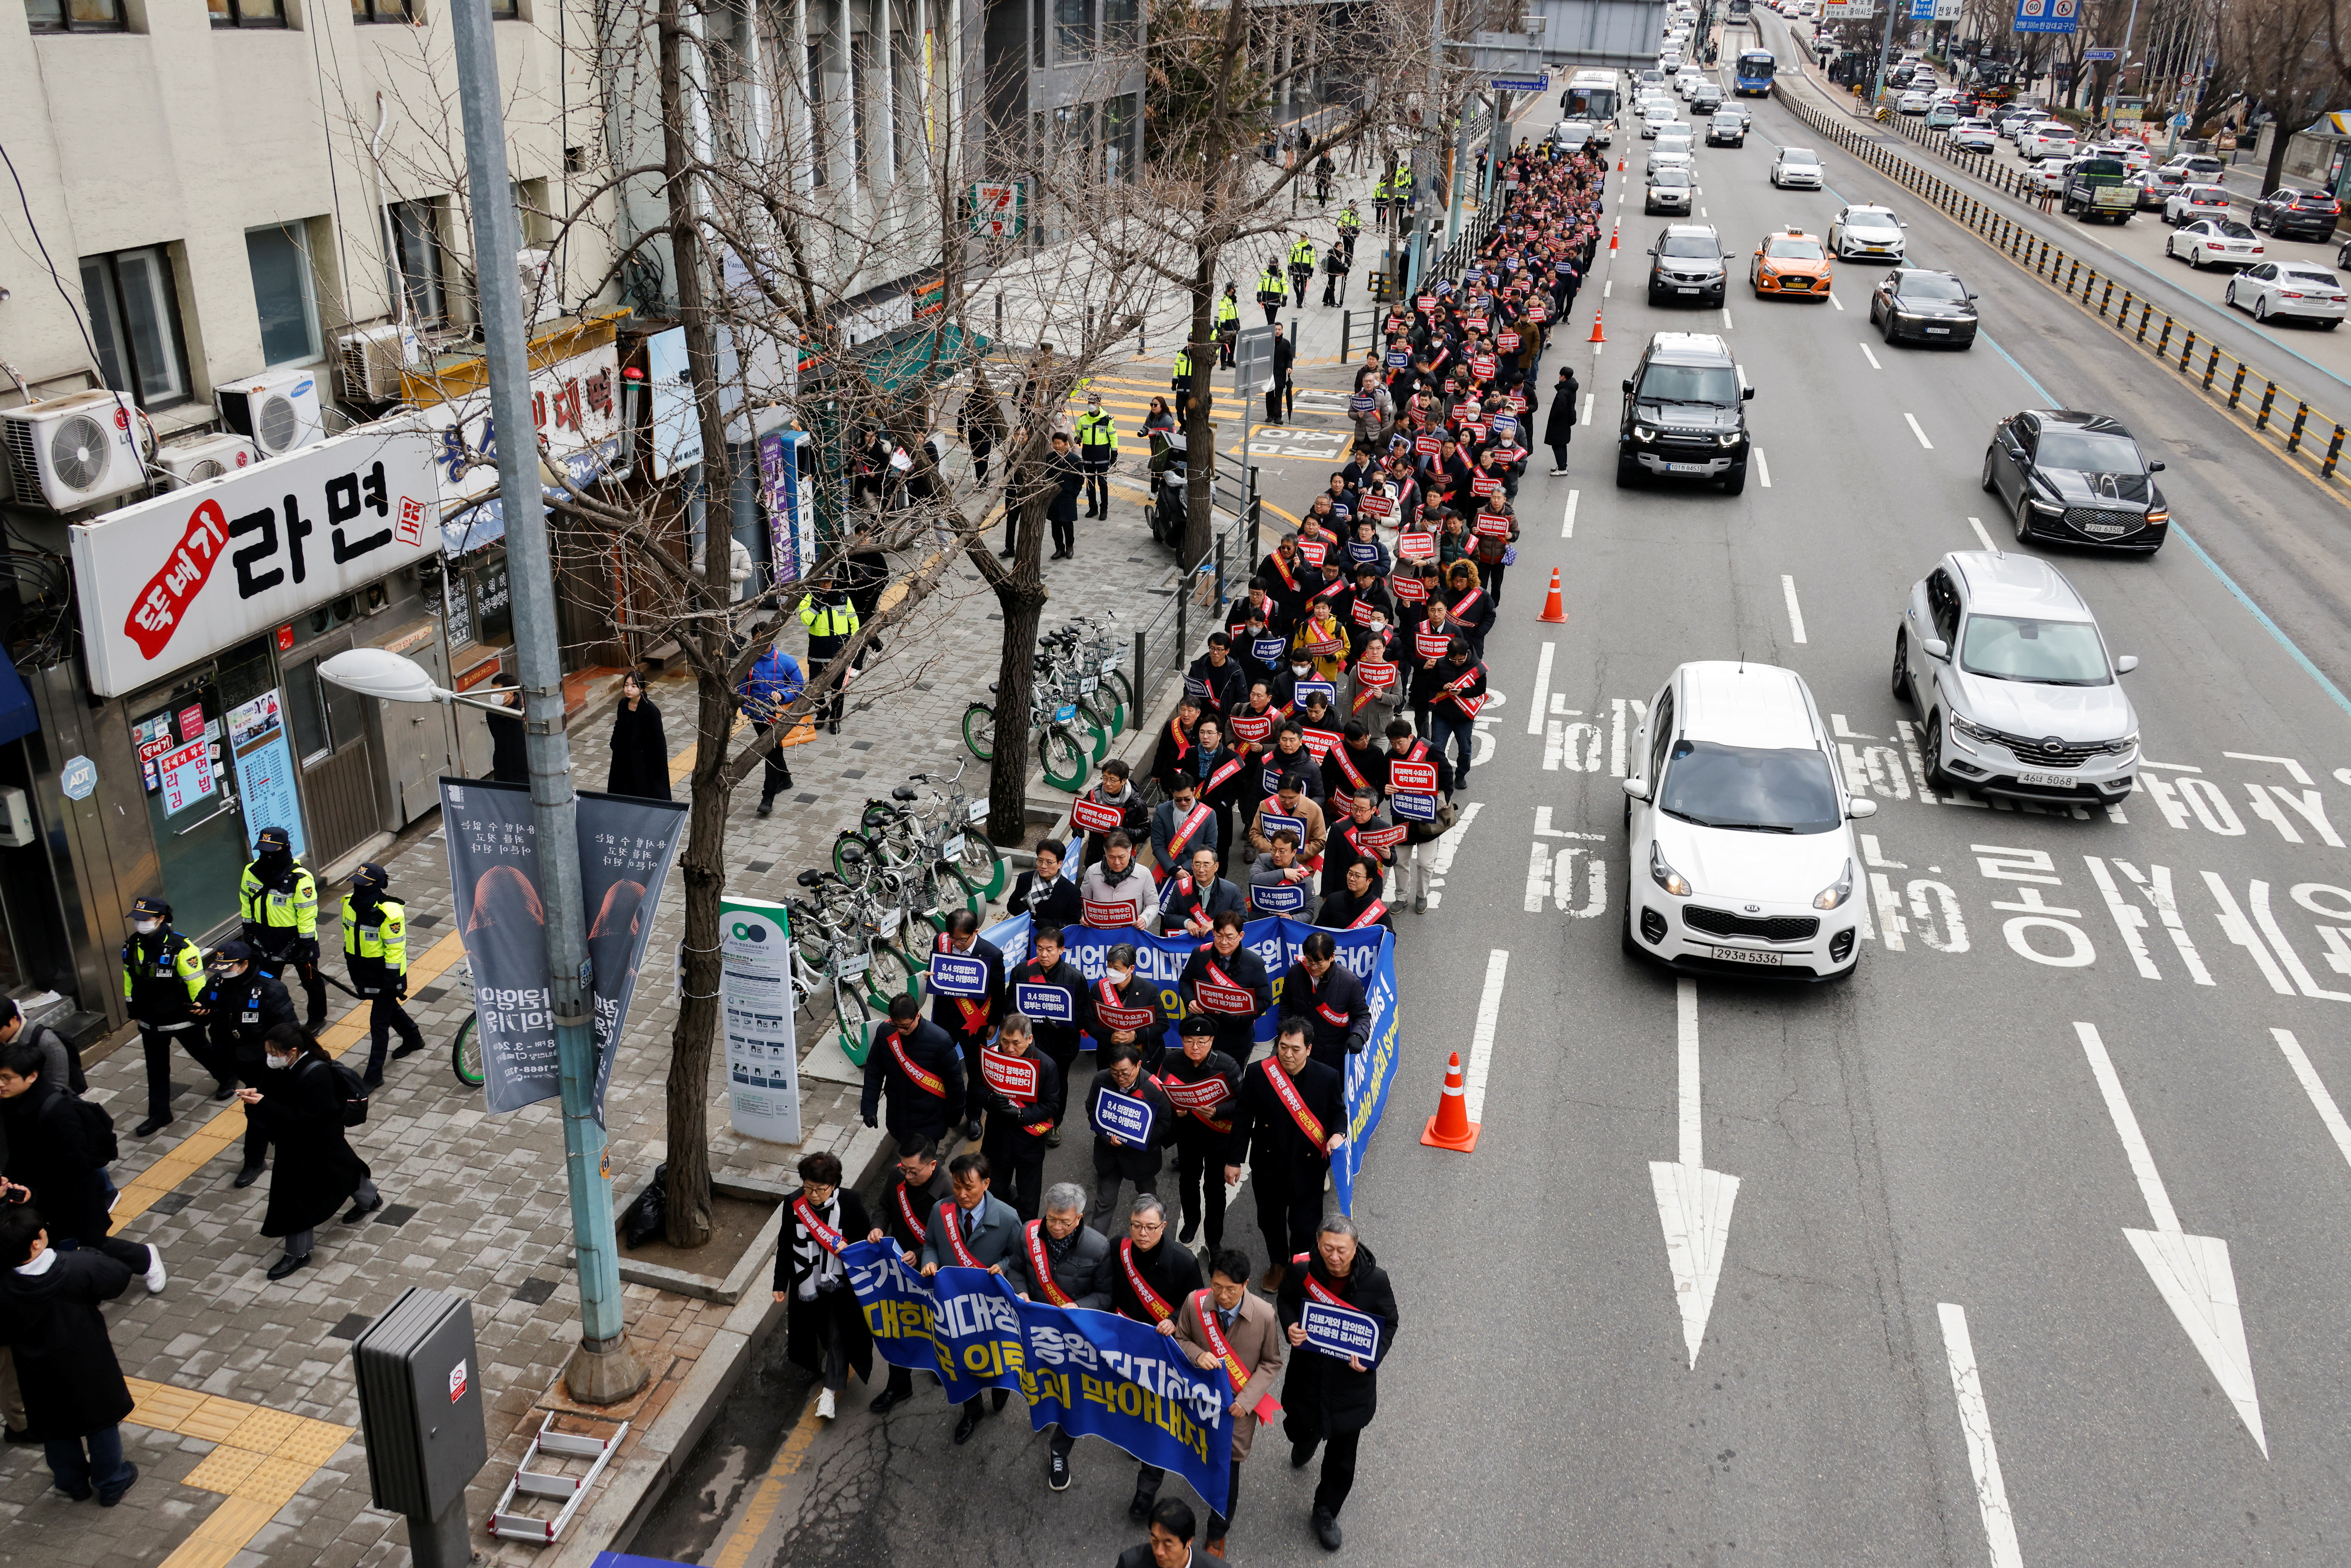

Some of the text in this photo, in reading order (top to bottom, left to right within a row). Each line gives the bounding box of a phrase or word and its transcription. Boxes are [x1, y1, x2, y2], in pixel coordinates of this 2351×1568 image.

[2039, 21, 2075, 31] 한강대교구간
[292, 383, 312, 394] SAMSUNG
[228, 461, 392, 599] 라면
[136, 510, 224, 631] 뚝배기
[477, 572, 507, 598] 막걸리
[478, 589, 509, 616] 녹두빈대떡
[448, 609, 469, 631] 빈대떡
[468, 666, 492, 681] 고압가스
[1234, 721, 1268, 730] 비과학적 수요조사
[143, 737, 170, 757] 뚝배기
[163, 742, 206, 771] 뚝배기 라면
[69, 766, 89, 789] ADT
[1409, 776, 1428, 784] 폐기하라
[2023, 774, 2071, 786] 46너 5068
[1413, 797, 1432, 806] 합의없는
[1413, 804, 1431, 812] 결사반대
[1078, 806, 1118, 823] 비과학적 수요조사
[1081, 813, 1111, 828] 즉각 폐기하라
[1087, 906, 1131, 915] 일방적인 정책추진
[1088, 912, 1131, 921] 국민건강 위협한다
[1717, 949, 1777, 964] 293라 5336
[582, 971, 592, 986] 316
[937, 972, 979, 984] 정부는 이행하라
[941, 963, 977, 976] 9.4 의정합의
[1023, 1000, 1065, 1012] 정부는 이행하라
[1027, 993, 1061, 1003] 9.4 의정합의
[1101, 1008, 1149, 1021] 비과학적 수요조사
[1119, 1017, 1143, 1026] 폐기하라
[891, 1039, 924, 1080] 의대정원 확대추진
[984, 1058, 1031, 1078] 일방적인 정책추진
[984, 1067, 1031, 1087] 국민건강 위협한다
[1170, 1083, 1220, 1098] 일방적인 정책추진
[1268, 1063, 1317, 1132] 일방적인 정책추진 국민건강
[1102, 1109, 1142, 1131] 정부는 이행하라
[1107, 1100, 1142, 1120] 9.4 의정합의
[899, 1190, 911, 1218] 의대정원
[798, 1203, 819, 1230] 의대정원
[945, 1212, 973, 1267] 일방적인 정책추진
[1030, 1224, 1049, 1283] 일방적인 정책추진
[1122, 1247, 1154, 1303] 일방적인 정책추진
[1308, 1282, 1336, 1306] 의대정원
[1308, 1313, 1373, 1338] 의료계와 합의없는
[1307, 1323, 1372, 1349] 의대증원 결사반대
[1208, 1325, 1244, 1380] 확대추진 의료체계
[1030, 1324, 1097, 1371] 증원
[1100, 1349, 1223, 1430] 저지하여
[1082, 1372, 1208, 1465] 막아내자
